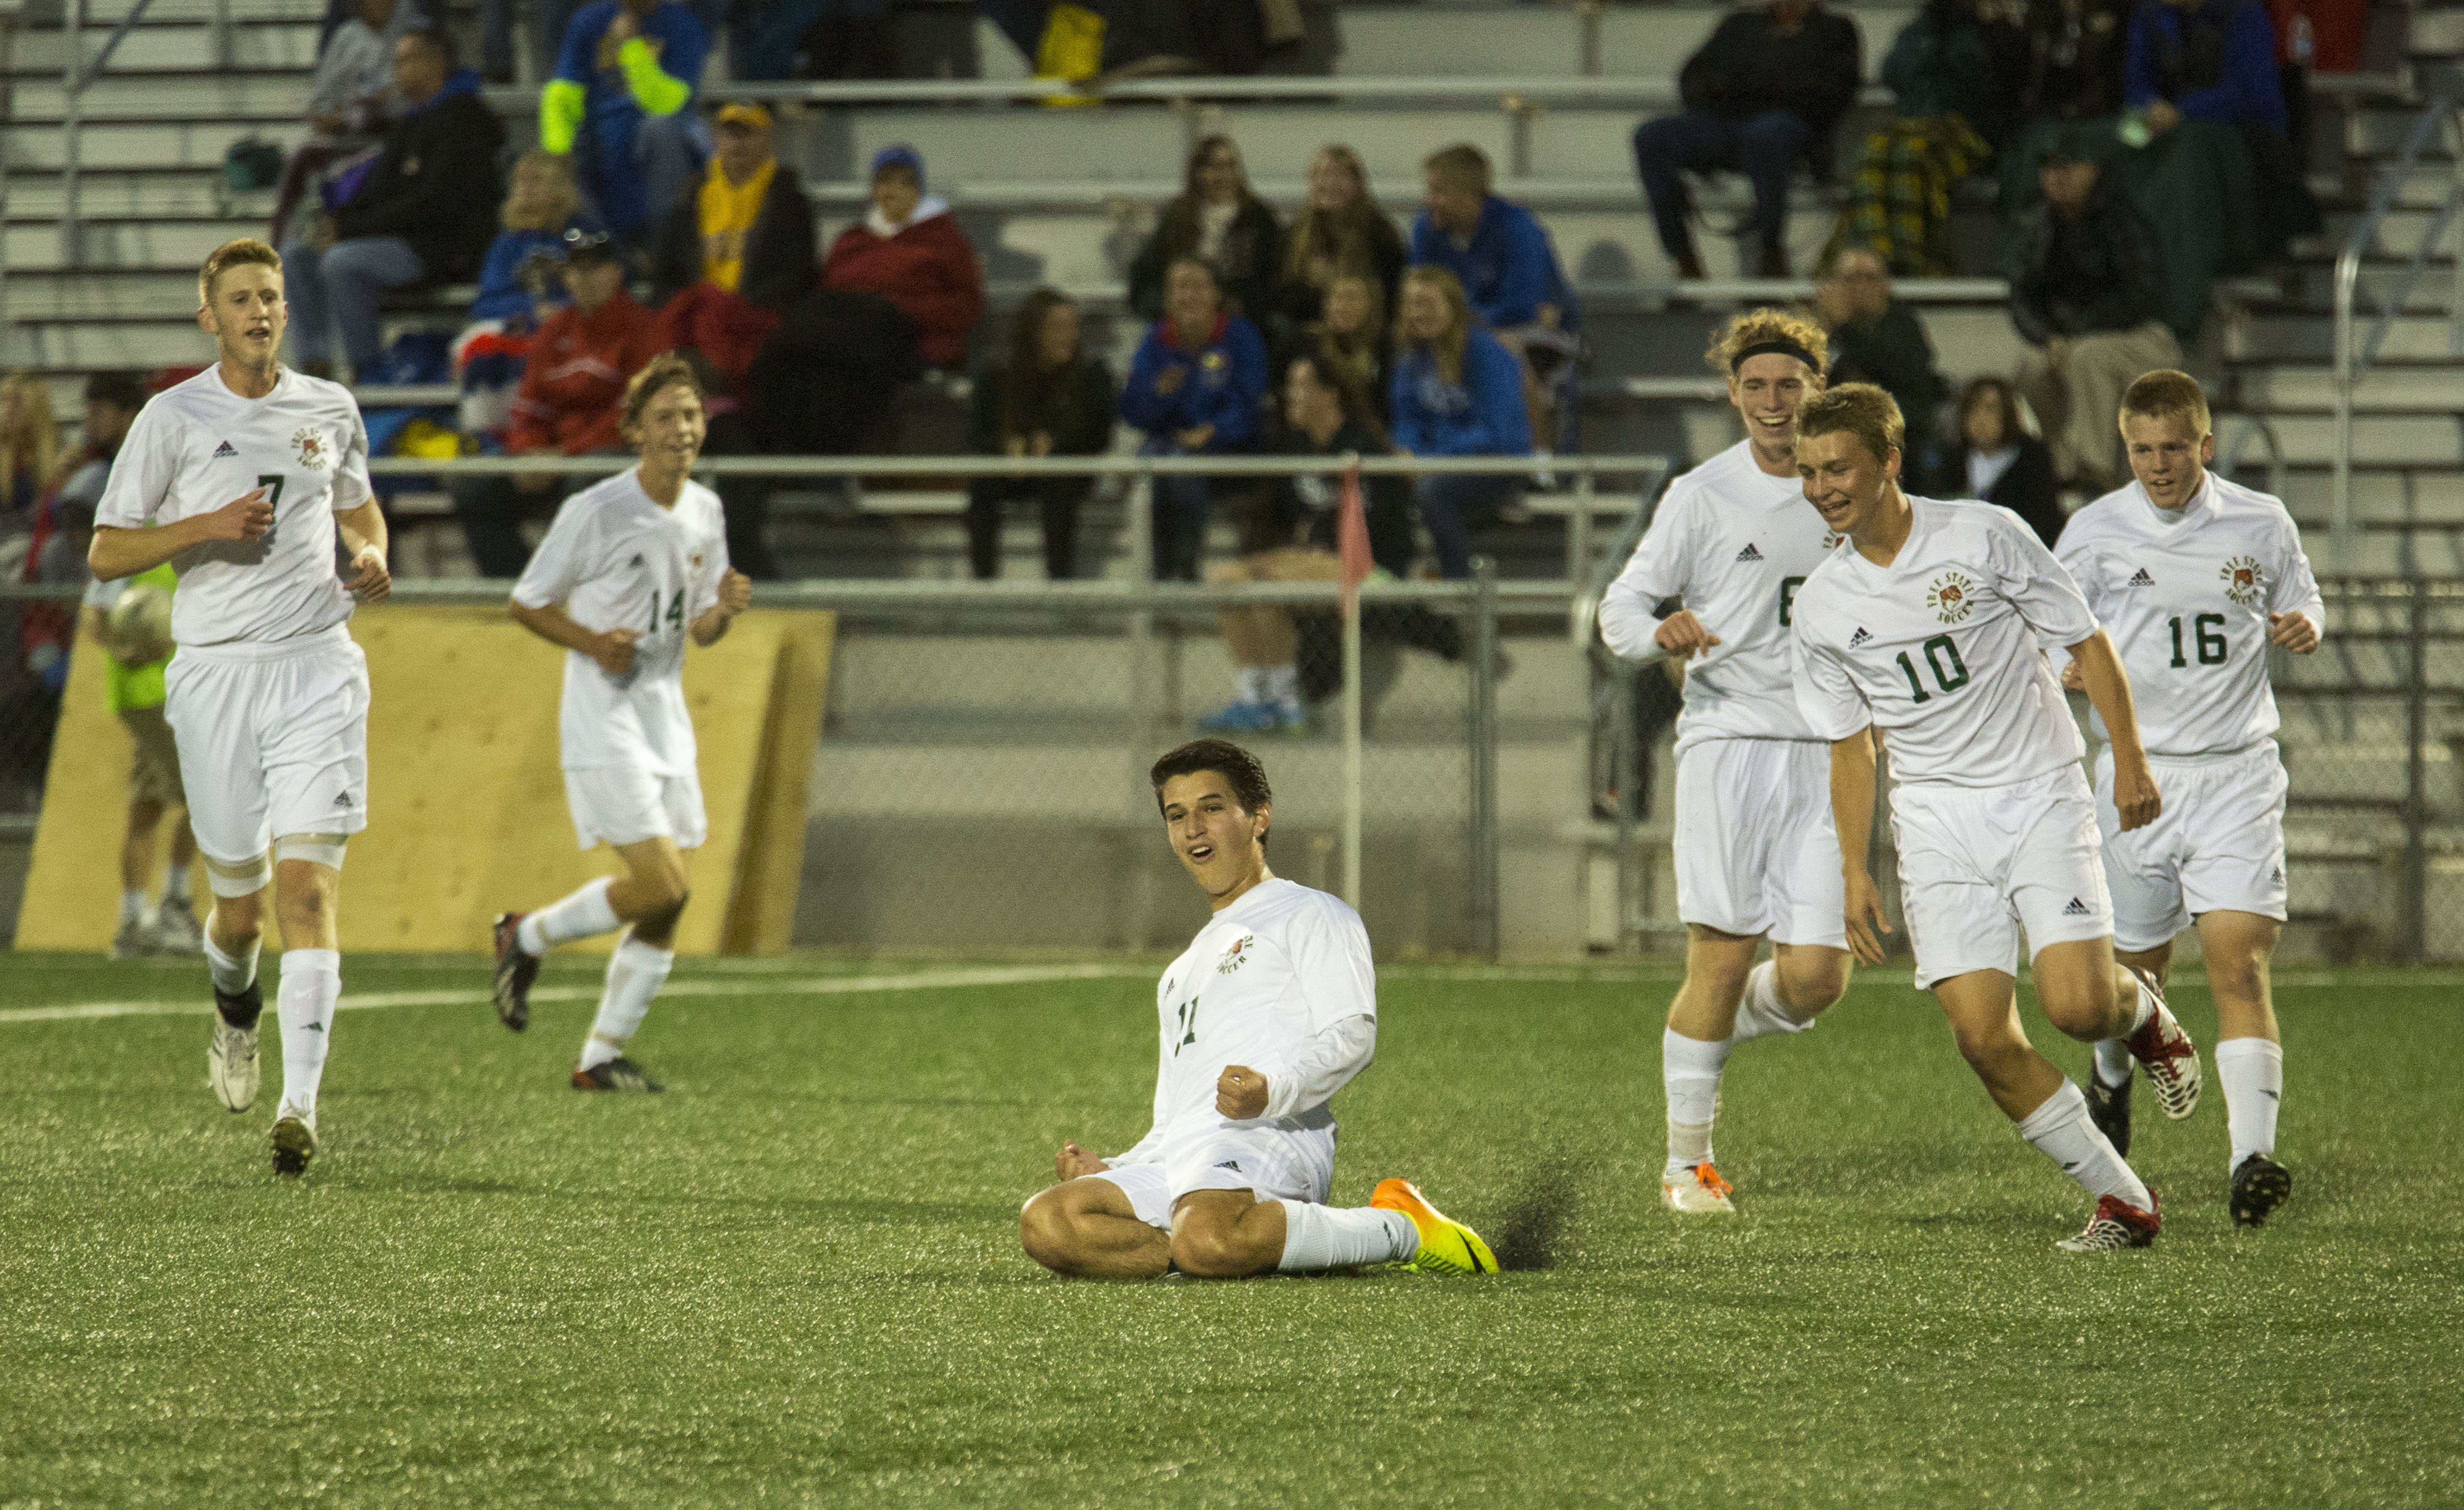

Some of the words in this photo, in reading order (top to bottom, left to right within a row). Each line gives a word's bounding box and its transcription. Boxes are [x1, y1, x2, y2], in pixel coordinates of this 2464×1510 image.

[258, 474, 284, 524] 7
[649, 587, 685, 634] 14
[1927, 578, 1943, 608] FREE
[1946, 572, 1974, 593] STATE
[1937, 599, 1974, 624] SOCCER
[2168, 613, 2227, 668] 16
[1896, 634, 1969, 704] 10
